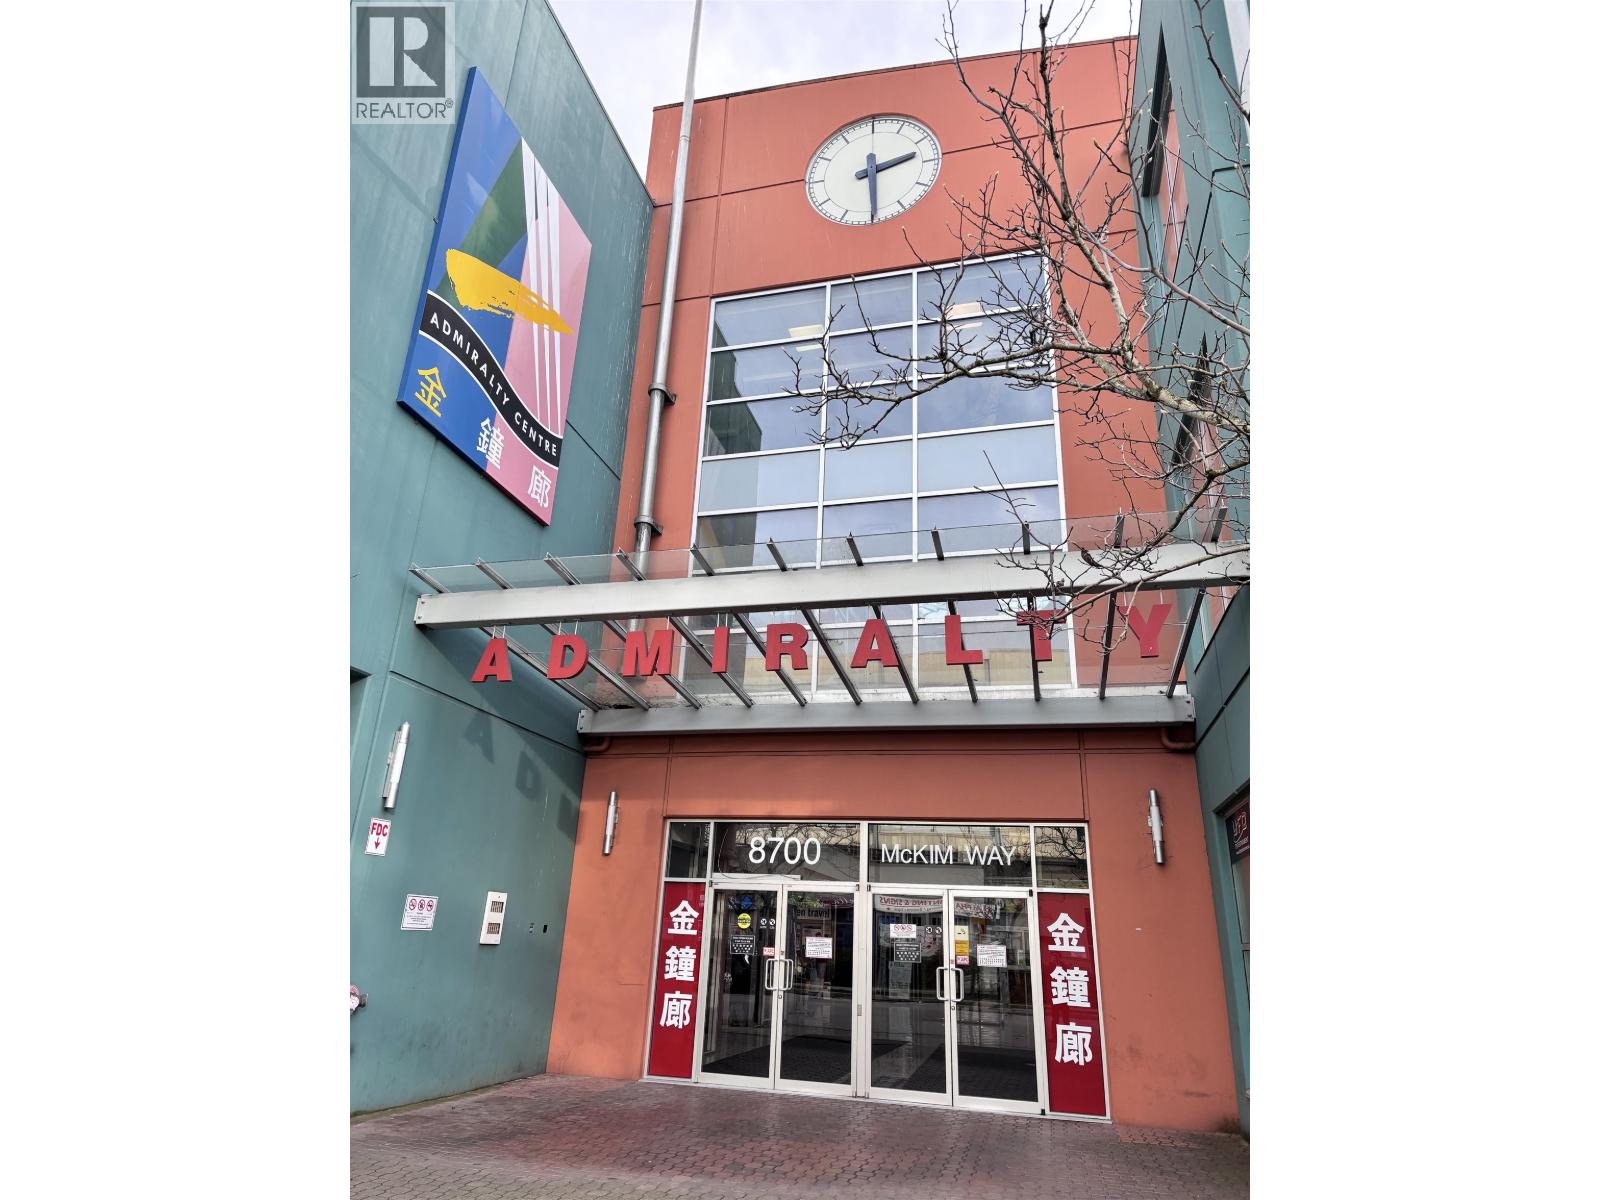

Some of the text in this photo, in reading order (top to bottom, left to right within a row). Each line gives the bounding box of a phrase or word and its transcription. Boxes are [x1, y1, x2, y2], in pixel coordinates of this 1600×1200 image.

[430, 312, 557, 457] ADMIRALTY CENTRE
[415, 367, 551, 508] 金鐘廊
[471, 603, 1173, 683] ADMIRALTY
[370, 822, 389, 837] FDC
[749, 837, 821, 865] 8700
[881, 843, 1017, 866] McKIM WAY
[659, 900, 699, 1029] 金鐘廊
[1047, 912, 1093, 1066] 金鐘廊
